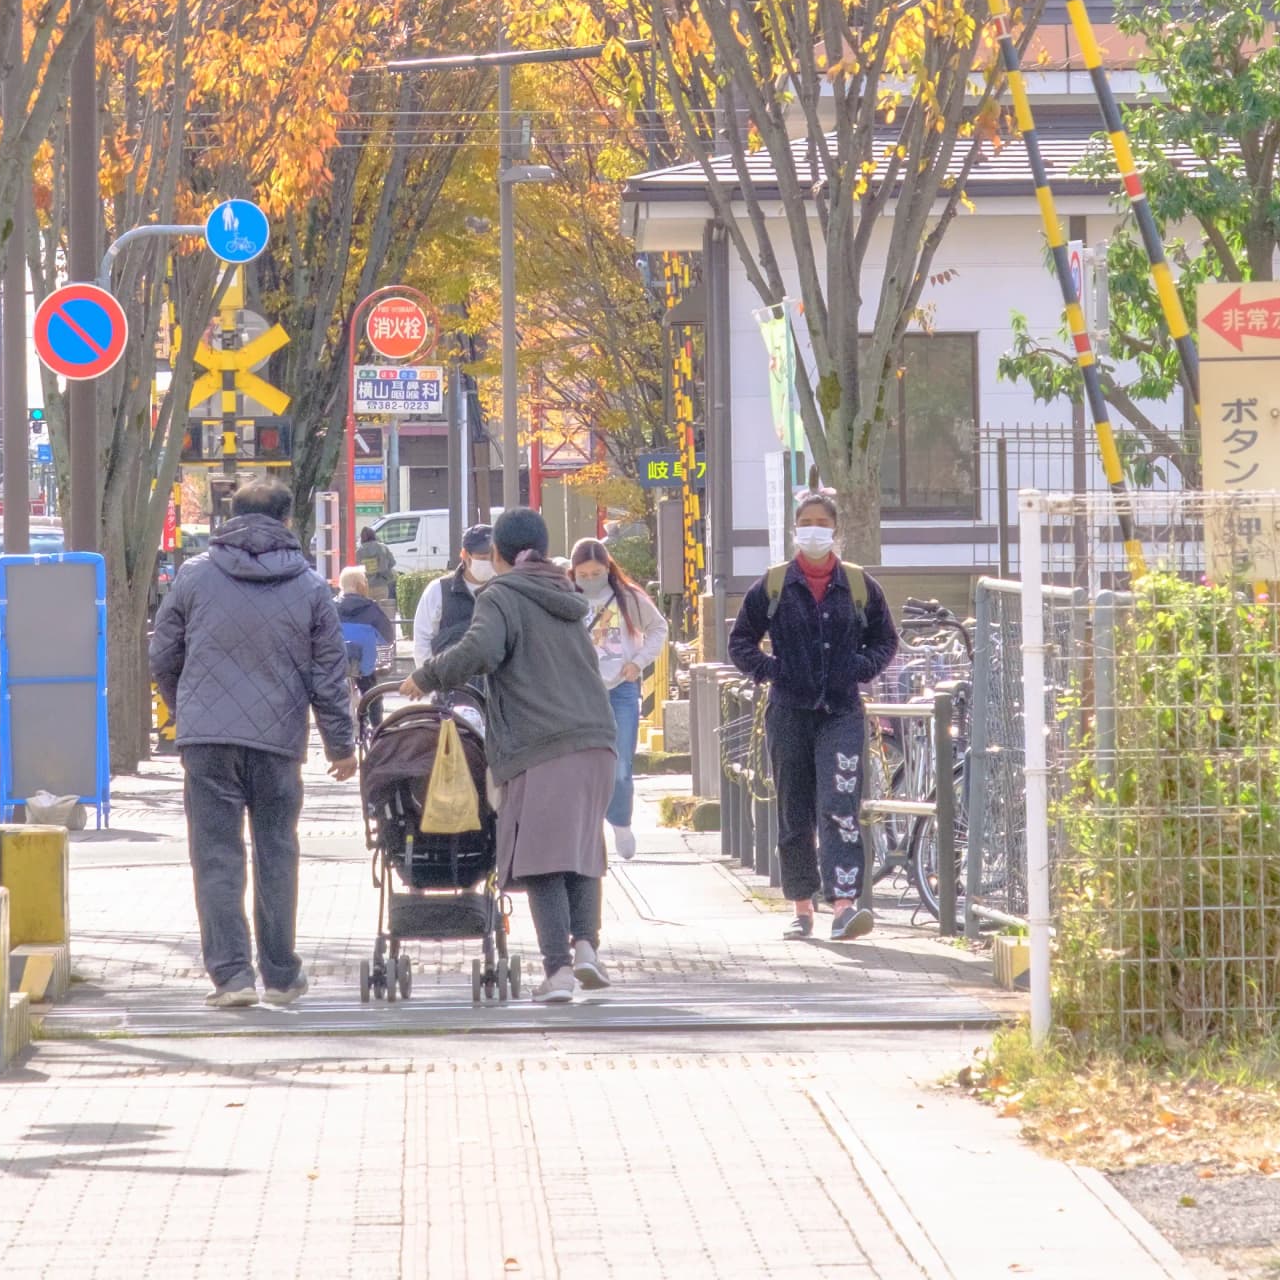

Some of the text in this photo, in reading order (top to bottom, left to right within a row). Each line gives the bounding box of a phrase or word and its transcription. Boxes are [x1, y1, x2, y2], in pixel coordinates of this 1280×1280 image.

[373, 317, 422, 339] 消火栓
[378, 401, 429, 410] 382-0223
